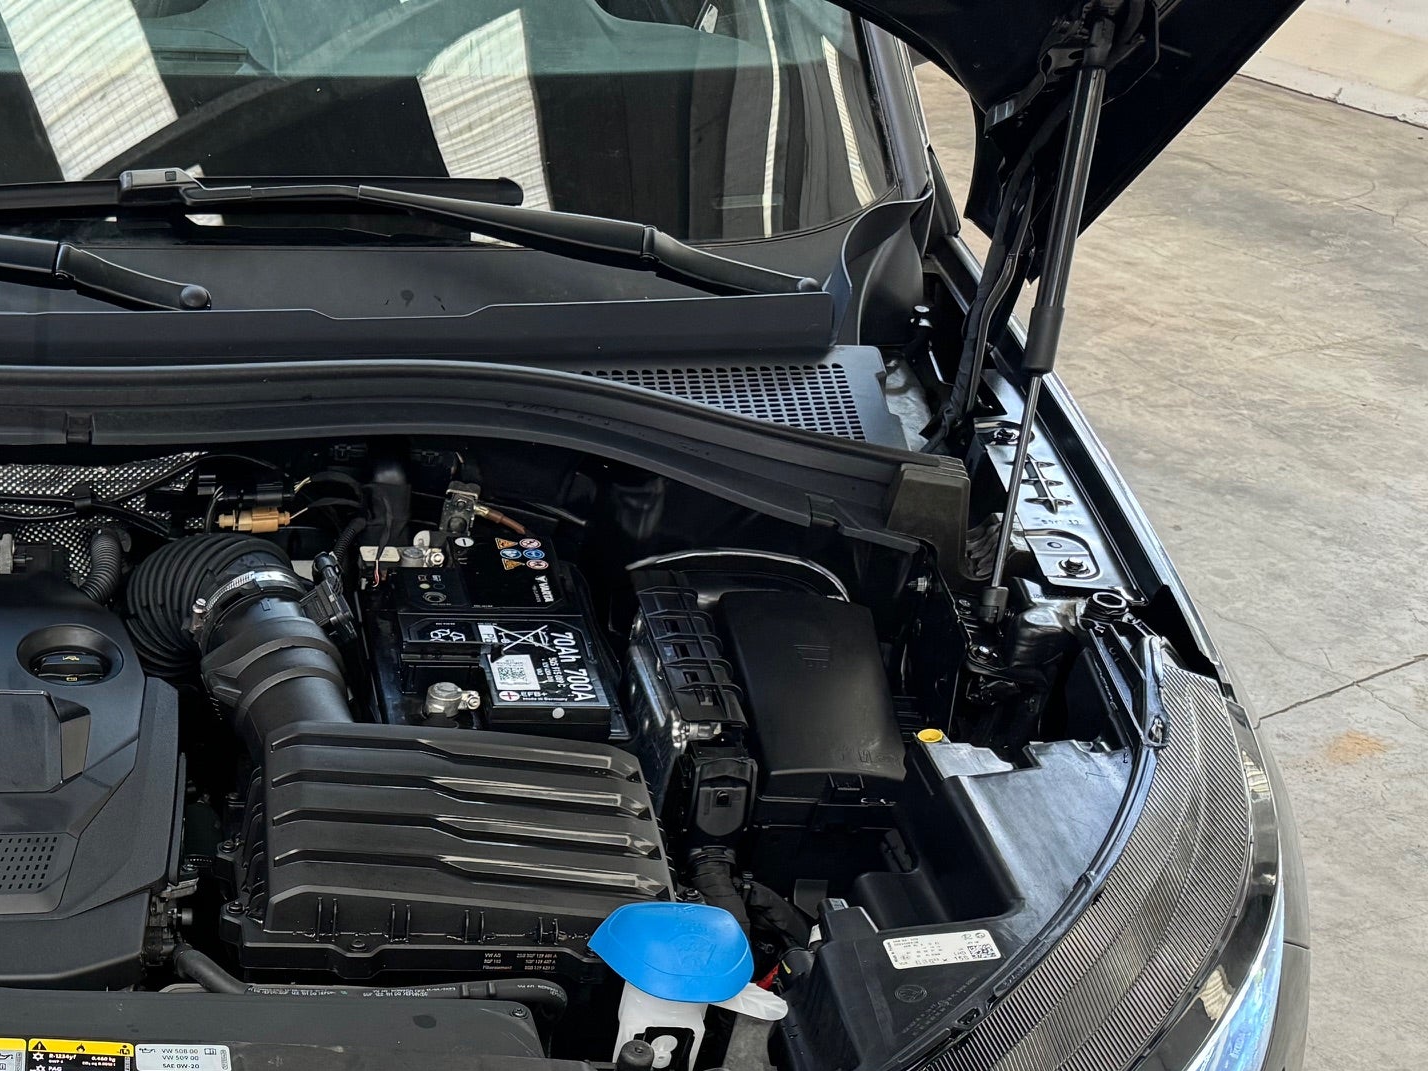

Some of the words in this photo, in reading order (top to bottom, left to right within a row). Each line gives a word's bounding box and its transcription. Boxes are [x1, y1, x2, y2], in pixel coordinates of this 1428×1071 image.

[539, 582, 554, 603] VARTA
[550, 632, 582, 663] 70Ah
[564, 668, 596, 702] 700A
[48, 1053, 77, 1061] R-1234yf
